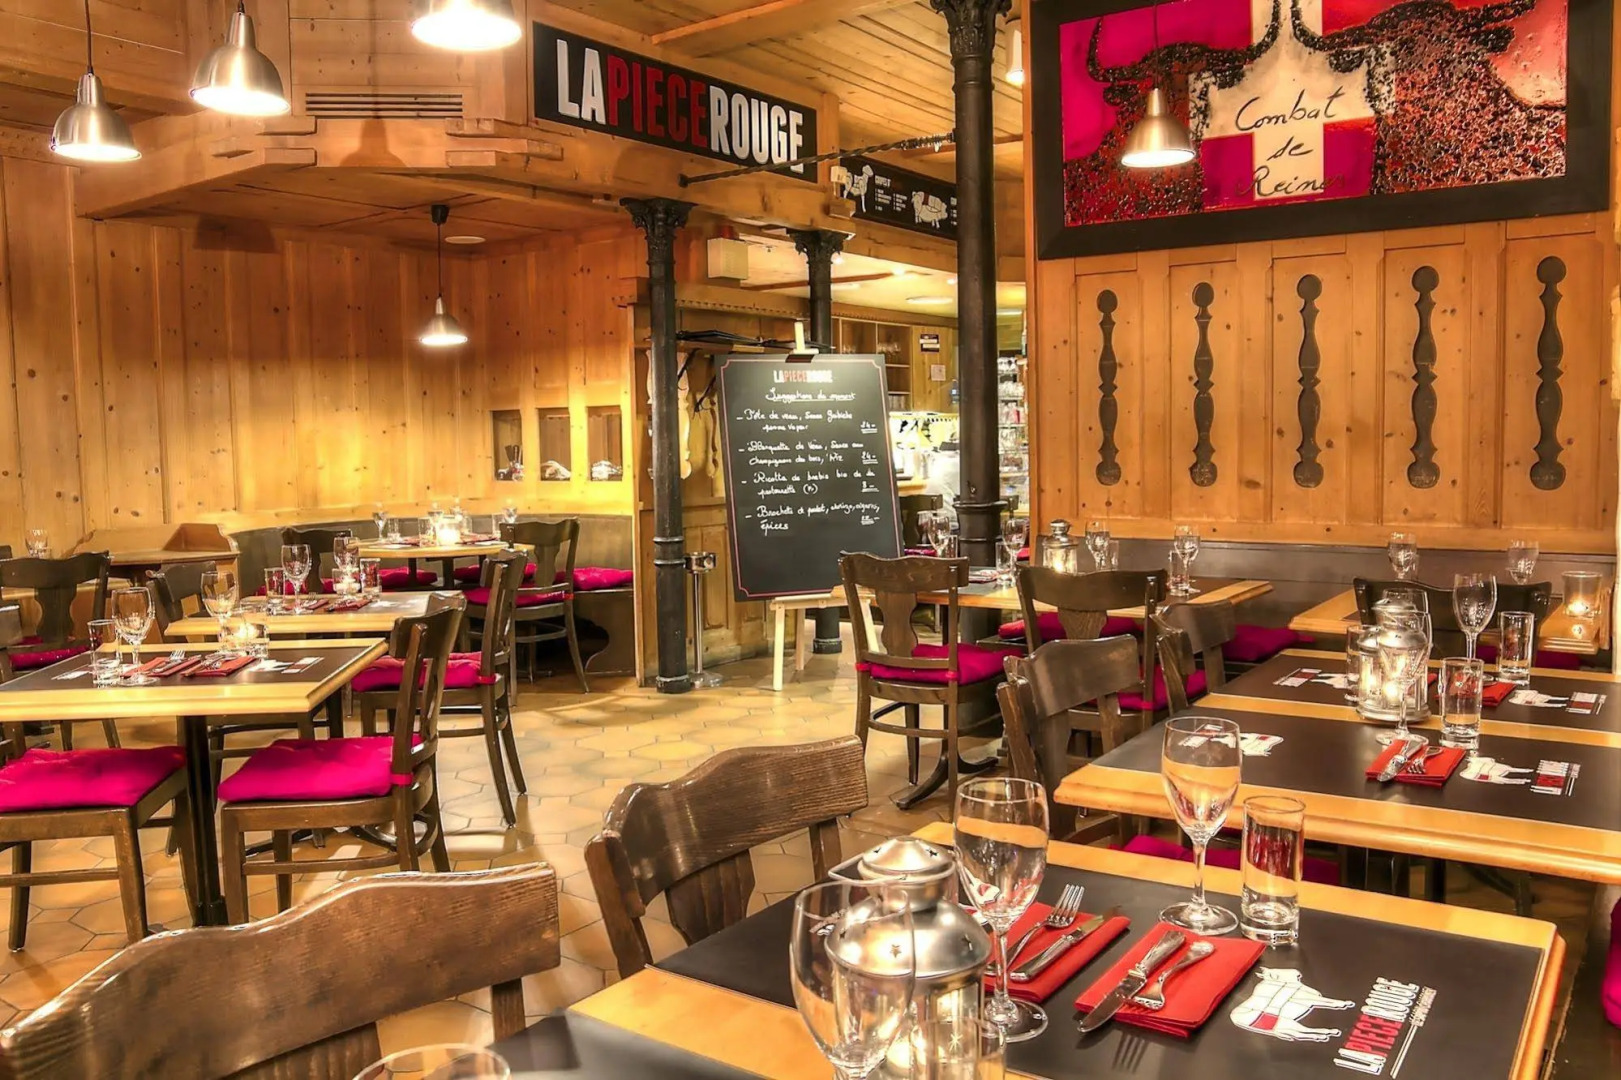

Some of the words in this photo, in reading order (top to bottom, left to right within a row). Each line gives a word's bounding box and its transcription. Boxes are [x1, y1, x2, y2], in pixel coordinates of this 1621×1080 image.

[1235, 86, 1345, 131] Combat
[1267, 136, 1313, 162] de
[769, 409, 780, 420] de
[795, 441, 805, 451] de
[836, 468, 848, 478] bio
